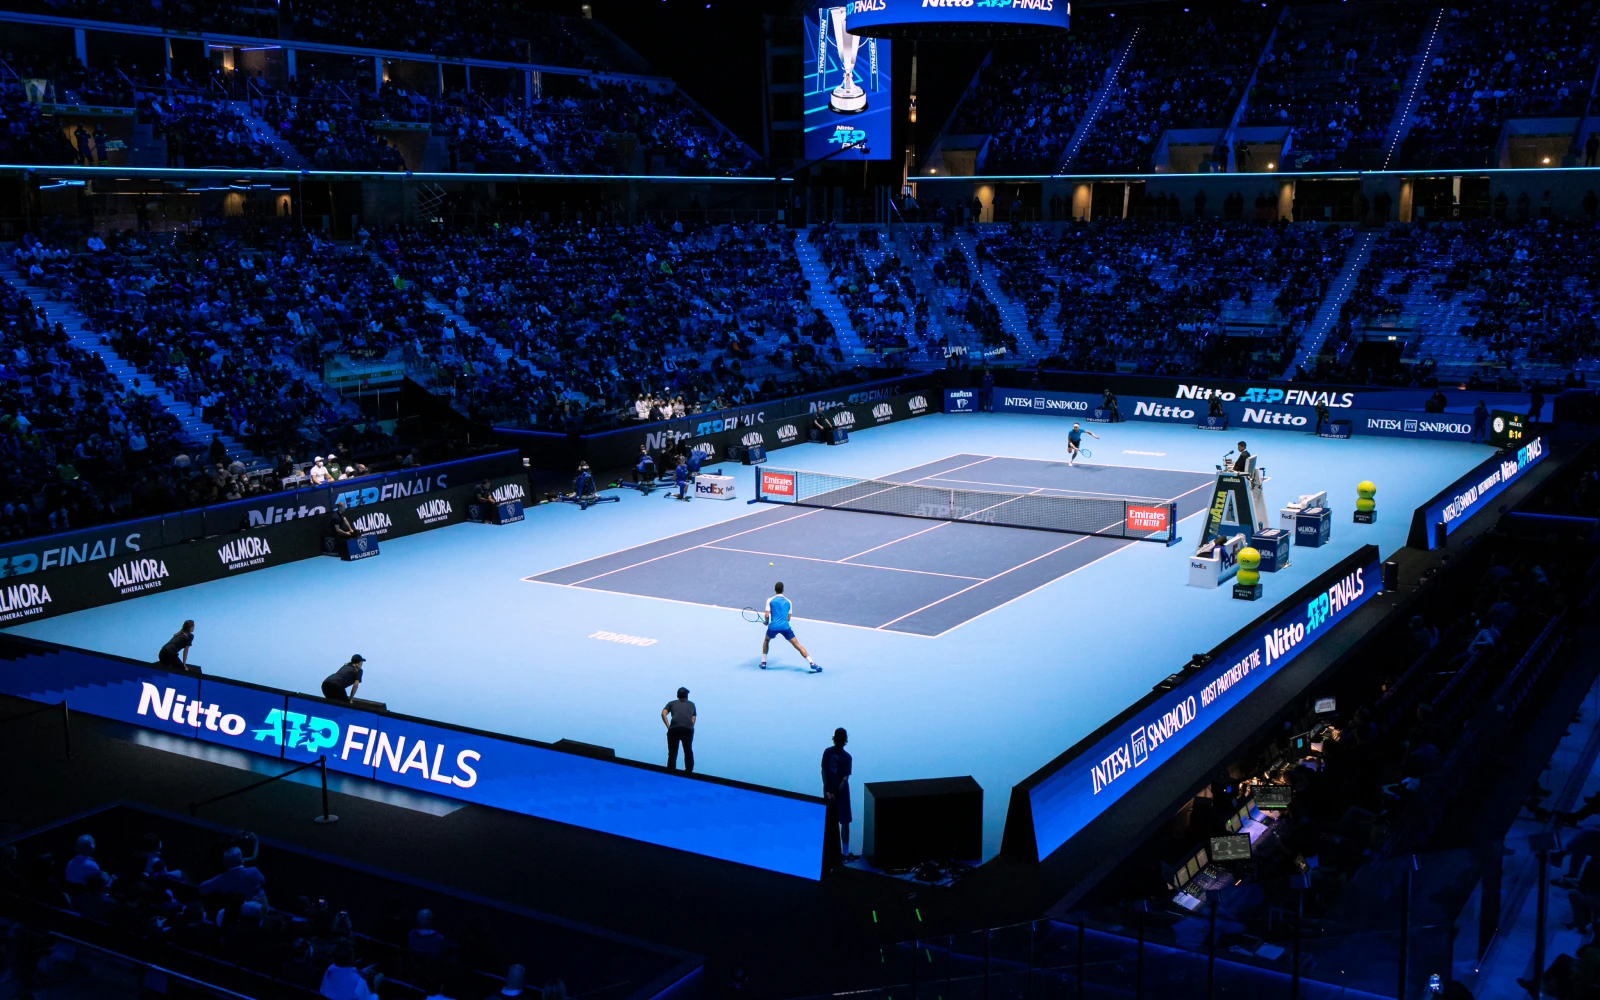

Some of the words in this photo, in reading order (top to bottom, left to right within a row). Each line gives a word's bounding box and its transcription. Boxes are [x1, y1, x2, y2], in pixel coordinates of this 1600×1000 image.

[1012, 0, 1053, 11] FINALS
[827, 130, 866, 144] ATP
[1004, 397, 1033, 408] INTESA
[1045, 399, 1088, 411] SANPAOLO
[1175, 384, 1236, 401] Nitto
[1239, 387, 1284, 403] ATP
[1284, 389, 1354, 408] FINALS
[1133, 401, 1195, 419] Nitto
[1241, 408, 1308, 426] Nitto
[1367, 418, 1402, 430] INTESA
[1419, 421, 1472, 434] SANPAOLO
[1501, 460, 1518, 482] Nitto
[1526, 436, 1542, 463] FINALS
[696, 482, 724, 495] FedEx
[763, 475, 793, 486] Emirates
[248, 504, 327, 528] Nitto
[381, 473, 448, 501] FINALS
[492, 483, 526, 503] VALMORA
[416, 498, 453, 520] VALMORA
[1129, 509, 1166, 520] Emirates
[353, 511, 393, 534] VALMORA
[1143, 519, 1160, 527] BETTER
[41, 533, 141, 571] FINALS
[217, 536, 272, 565] VALMORA
[350, 549, 379, 560] PEUGEOT
[229, 561, 250, 570] MINERAL
[250, 557, 265, 566] WATER
[1191, 561, 1207, 570] FedEx
[108, 558, 170, 588] VALMORA
[121, 583, 145, 595] MINERAL
[145, 580, 162, 590] WATER
[0, 611, 24, 622] INERAL
[24, 606, 43, 617] WATER
[587, 630, 658, 646] TORINO
[1090, 743, 1132, 795] INTESA
[1147, 695, 1197, 751] SANPAOLO
[1200, 680, 1217, 708] HOST
[1216, 662, 1243, 696] PARTNER
[1241, 656, 1250, 676] OF
[1248, 648, 1261, 670] THE
[1263, 622, 1304, 667] Nitto
[1304, 592, 1329, 635] ATP
[1329, 567, 1364, 617] FINALS
[136, 681, 247, 737] Nitto
[250, 708, 340, 754] ATP
[341, 724, 482, 789] FINALS
